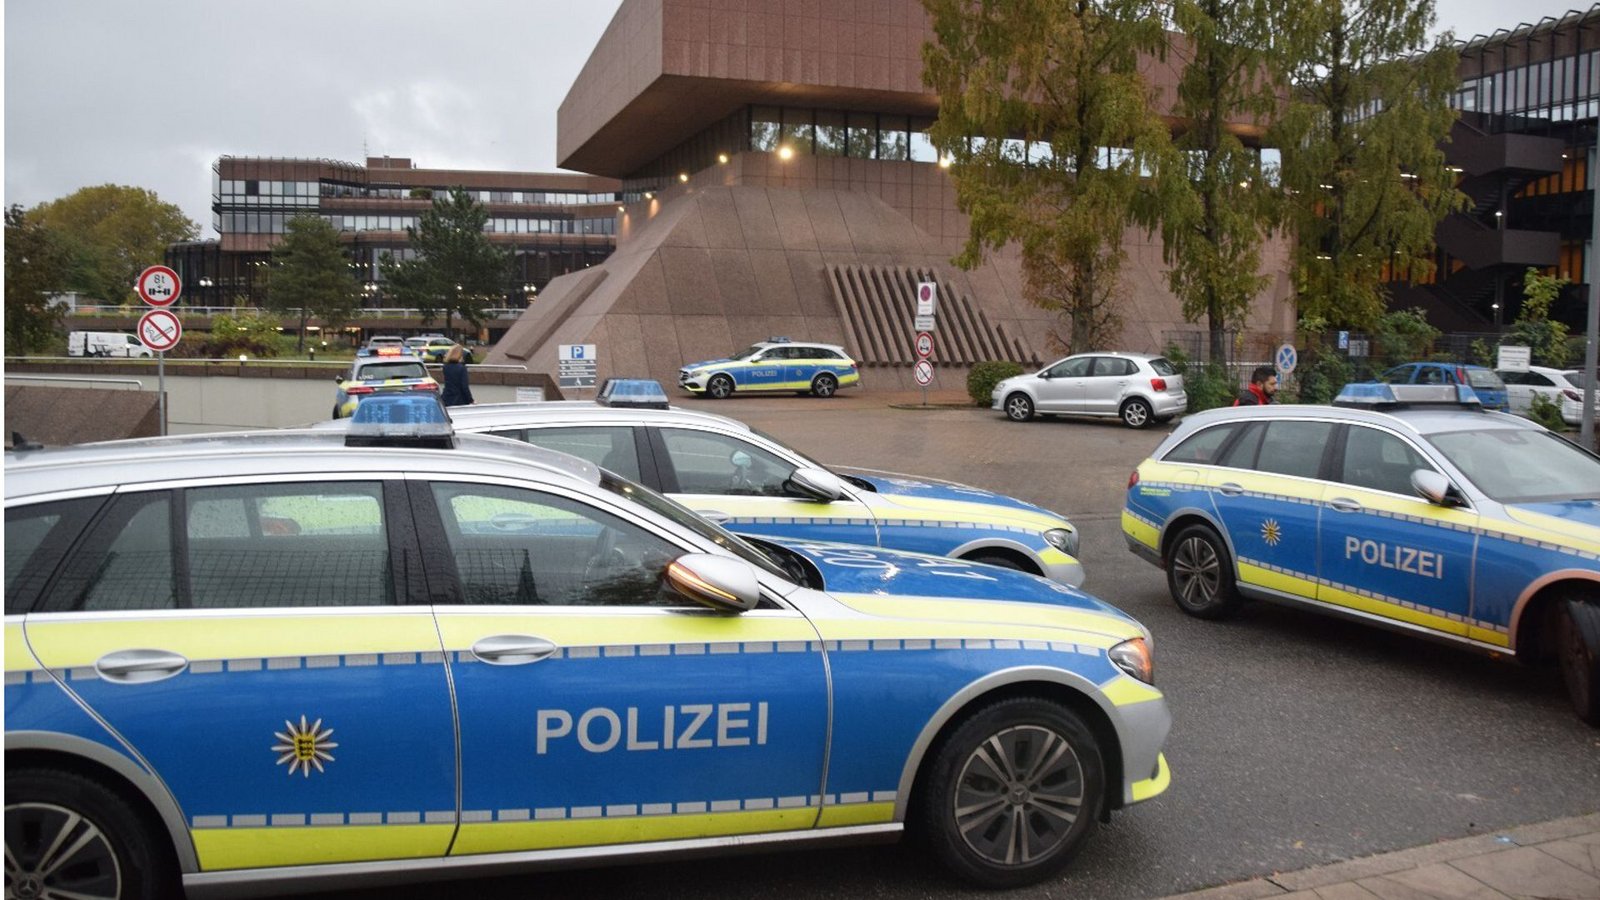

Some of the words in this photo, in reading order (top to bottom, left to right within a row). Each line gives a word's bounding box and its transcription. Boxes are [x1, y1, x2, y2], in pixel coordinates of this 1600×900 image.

[573, 346, 583, 359] P
[751, 370, 777, 378] POLIZEI
[1345, 535, 1443, 579] POLIZEI
[536, 701, 769, 755] POLIZEI
